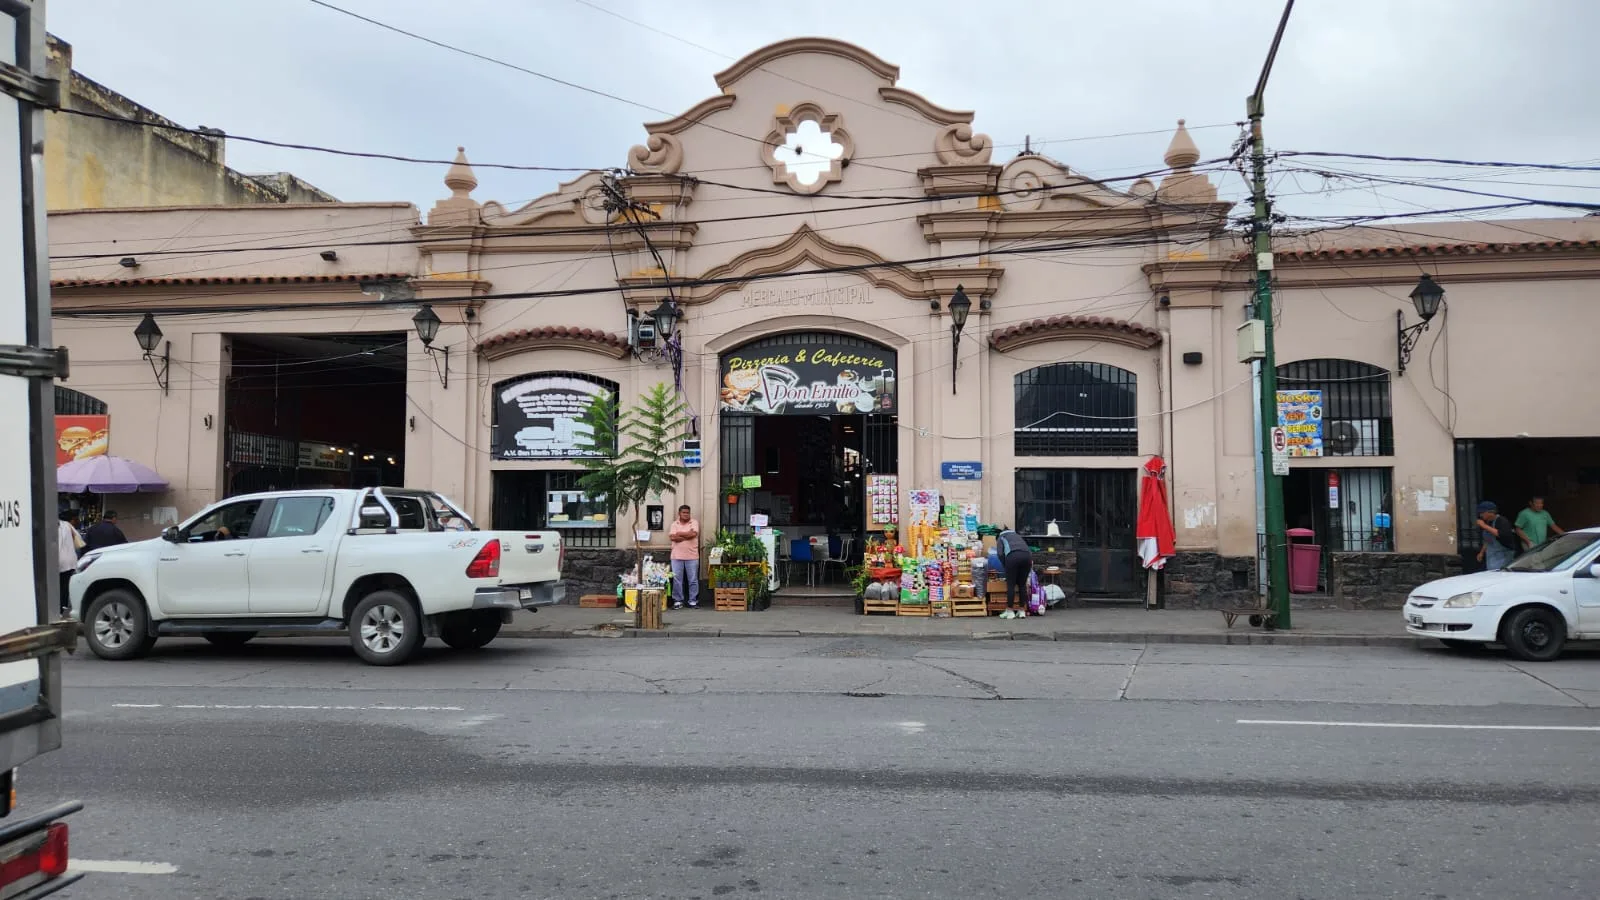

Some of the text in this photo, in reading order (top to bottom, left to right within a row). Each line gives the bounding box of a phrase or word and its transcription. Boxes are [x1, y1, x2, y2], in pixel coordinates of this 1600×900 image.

[742, 286, 873, 307] MERCADO MUNICIPAL
[794, 348, 806, 363] &
[773, 382, 860, 400] Don Emilio
